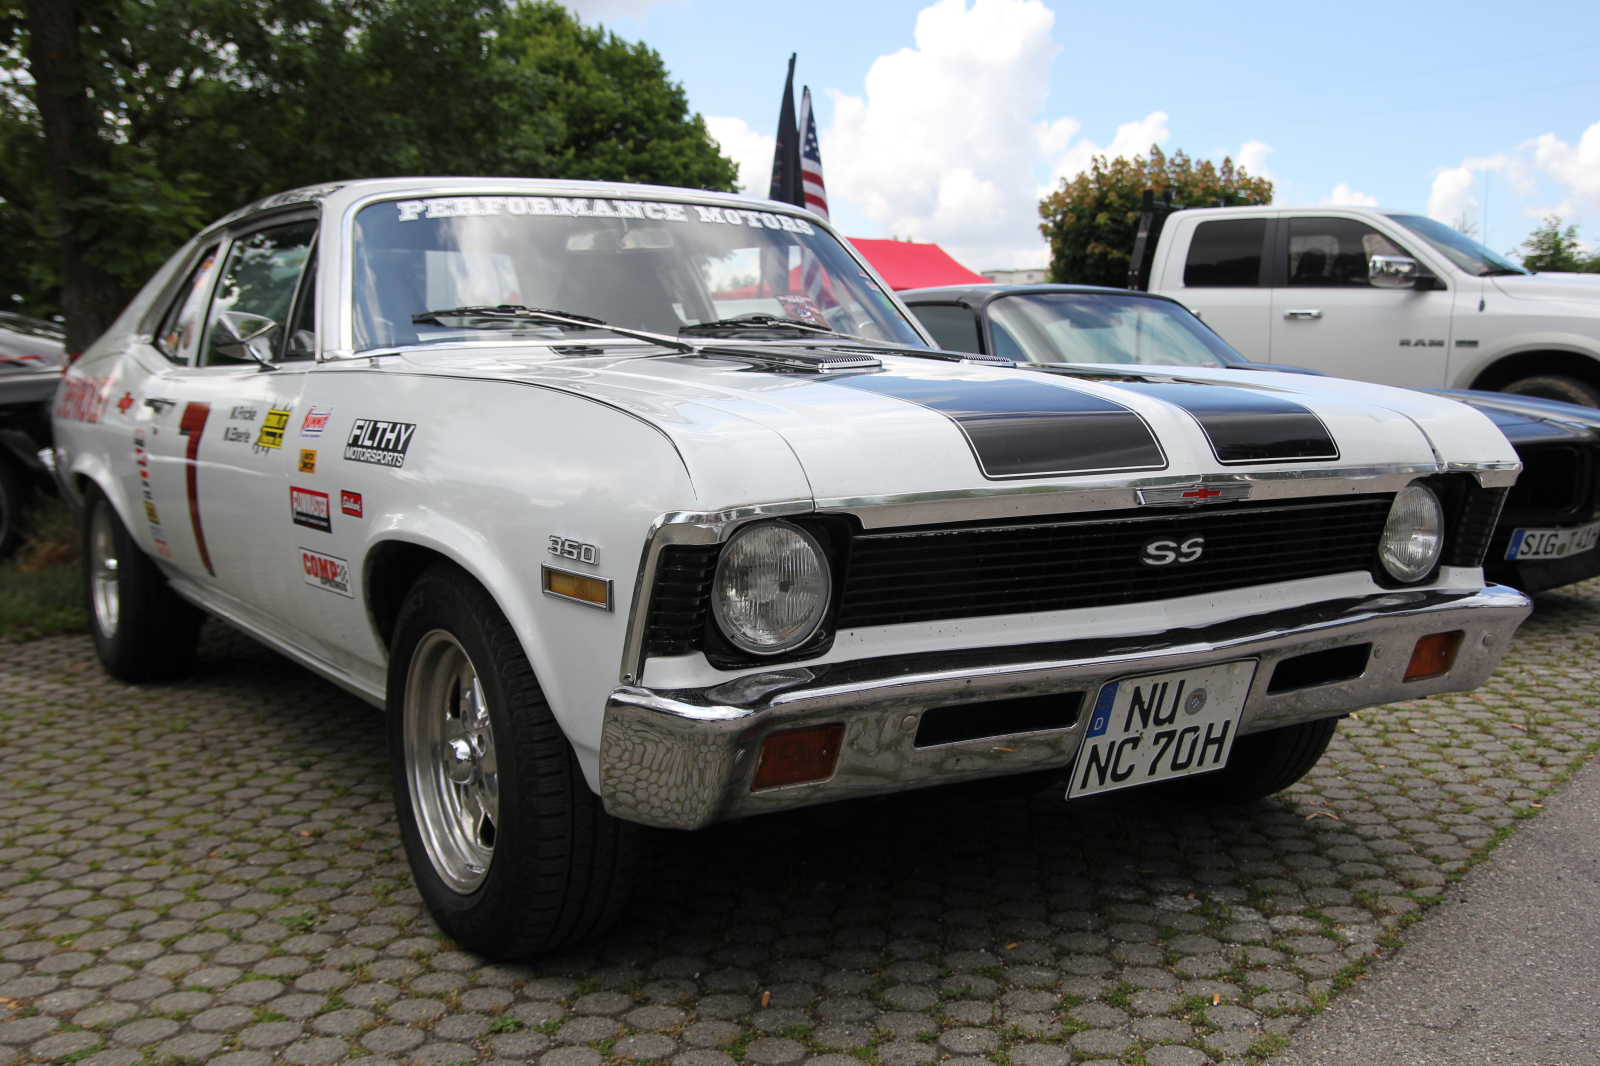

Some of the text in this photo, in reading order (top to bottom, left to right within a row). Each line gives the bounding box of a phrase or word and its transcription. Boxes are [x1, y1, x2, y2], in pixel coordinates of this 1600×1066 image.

[397, 196, 816, 236] PERFORMANCE MOTORS
[1399, 339, 1444, 347] RAM
[348, 420, 415, 451] FILTHY
[345, 446, 405, 467] MOTORSPORTS
[548, 534, 600, 566] 350
[1143, 537, 1204, 565] SS
[1520, 533, 1559, 555] SIG
[303, 552, 338, 580] COMP
[1124, 679, 1186, 733] NU
[1094, 717, 1103, 731] D
[1080, 720, 1232, 790] NC 70H
